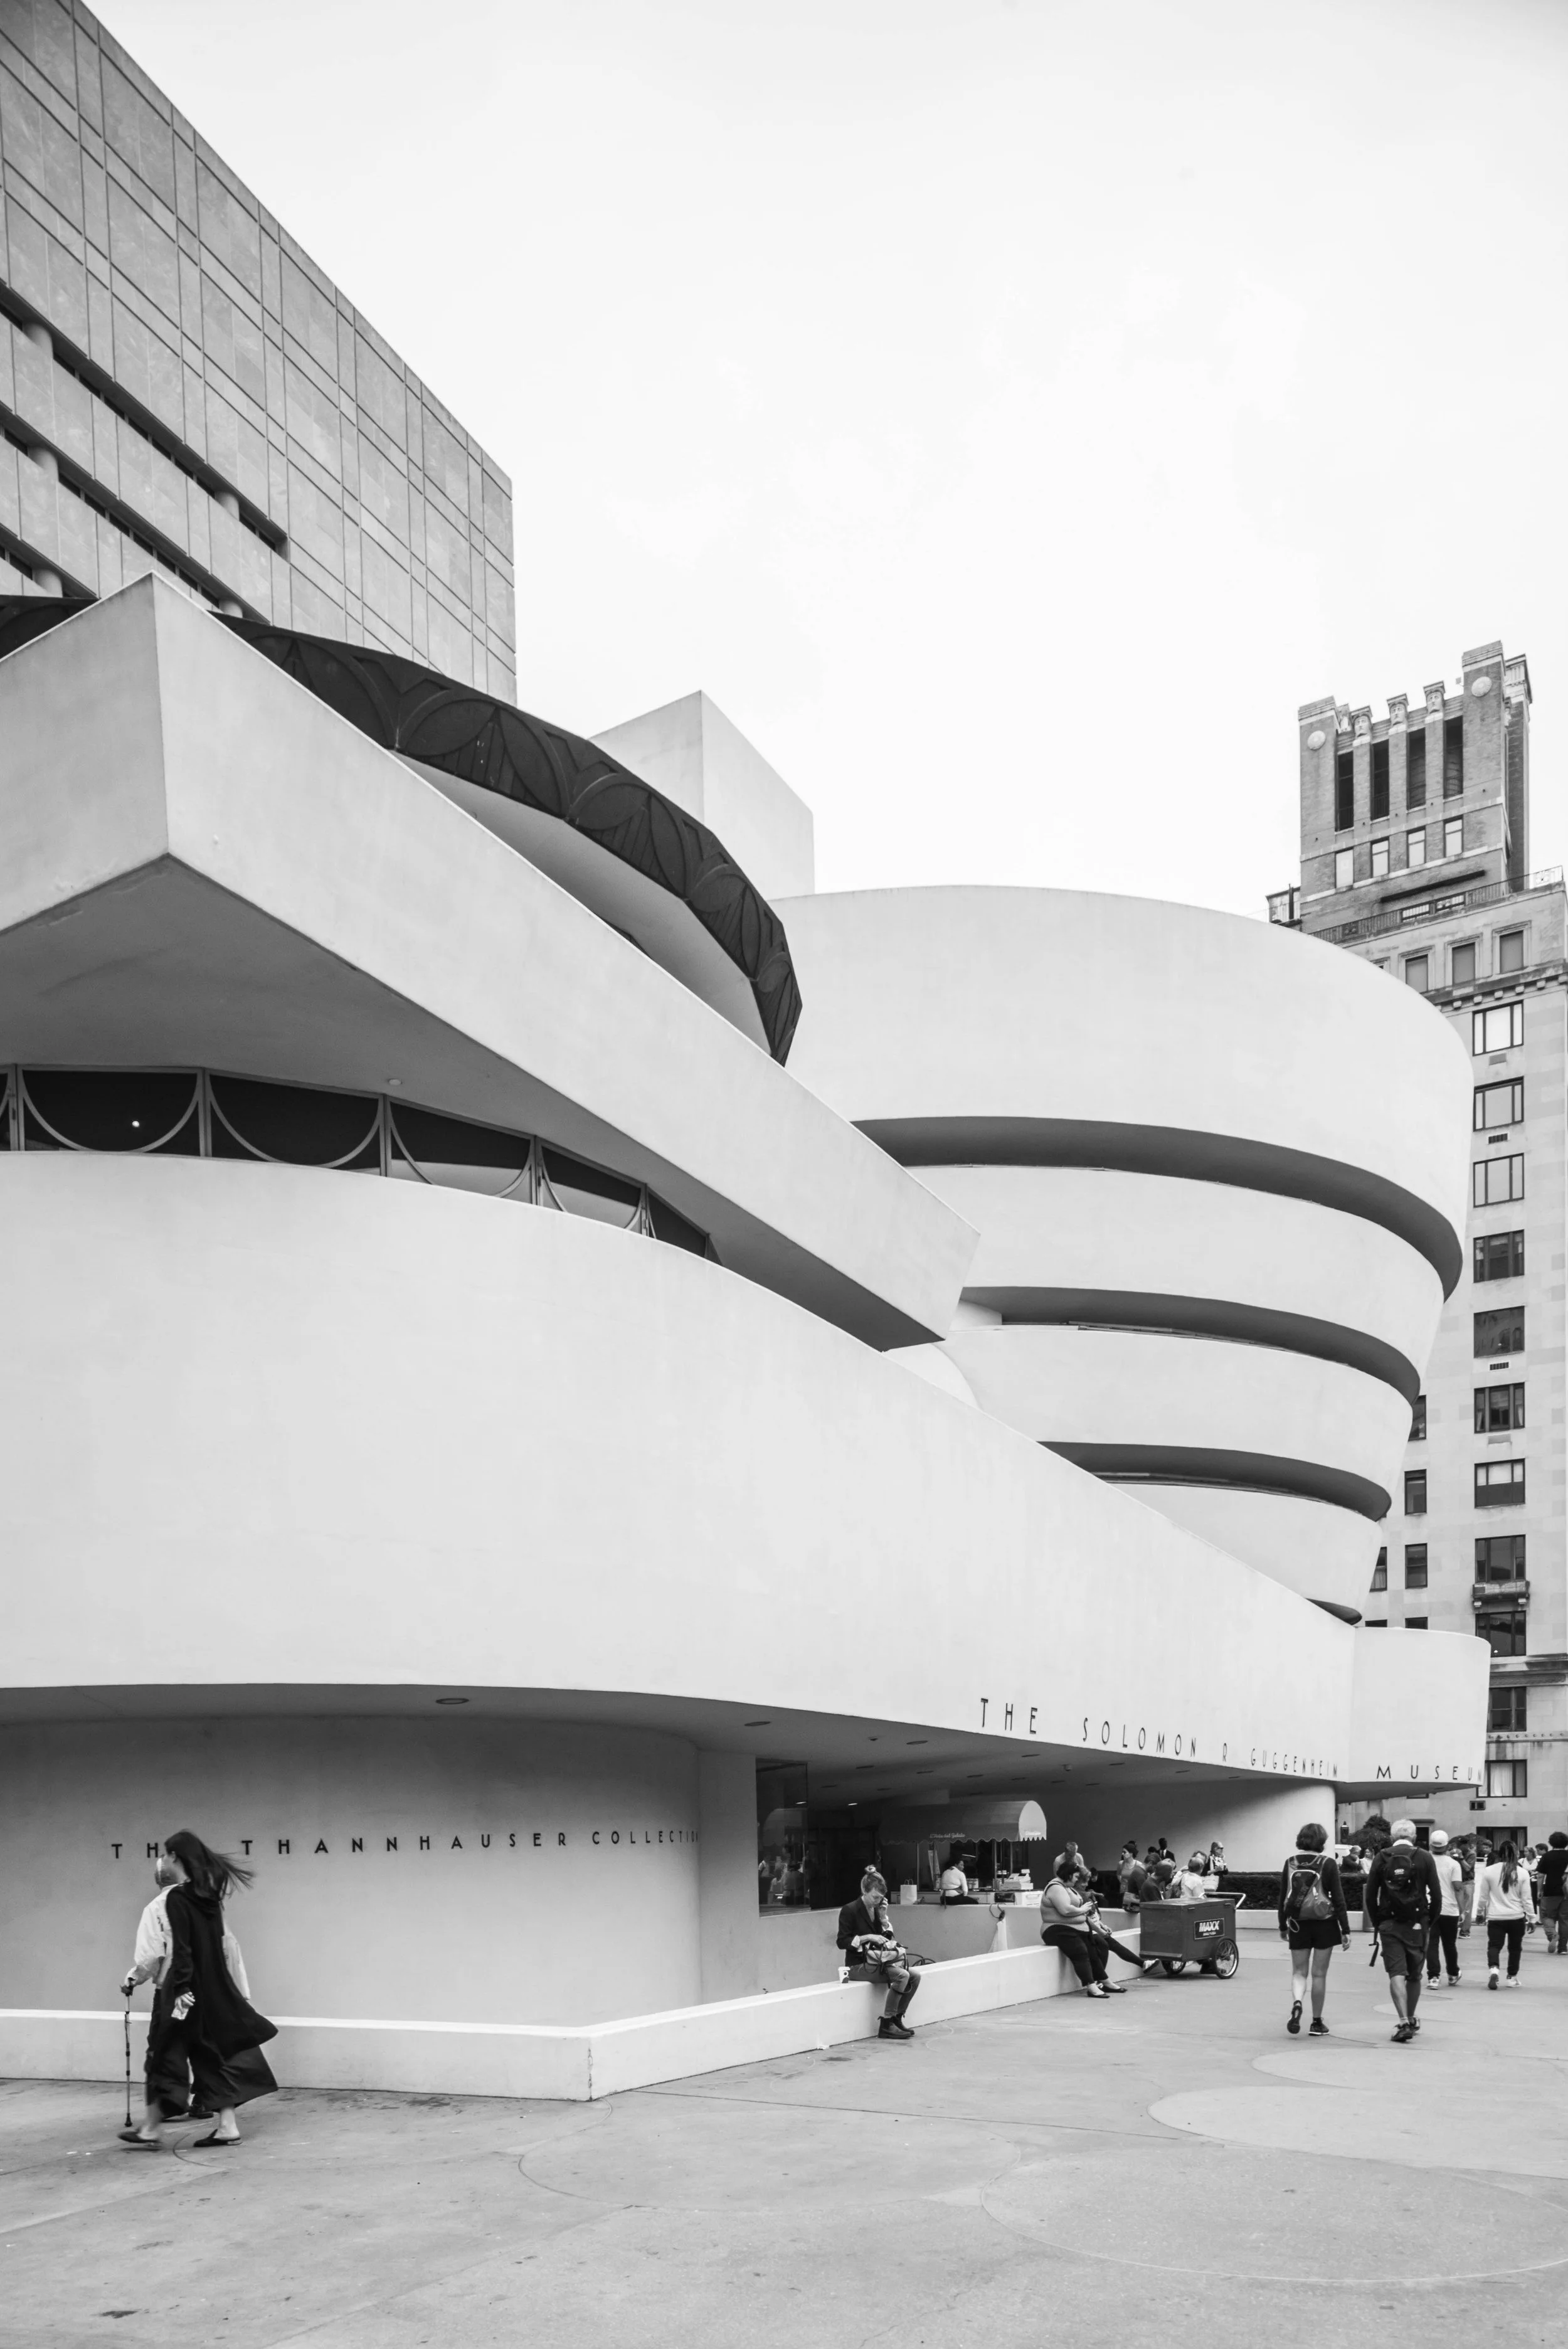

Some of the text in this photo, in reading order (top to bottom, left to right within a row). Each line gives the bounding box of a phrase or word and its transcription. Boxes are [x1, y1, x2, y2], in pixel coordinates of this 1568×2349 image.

[980, 1697, 1483, 1783] THE SOLOMON R GUGGENHEIM MUSEUM
[111, 1842, 159, 1859] TH
[241, 1832, 567, 1856] THANNHAUSER
[1199, 1920, 1220, 1933] MAXX
